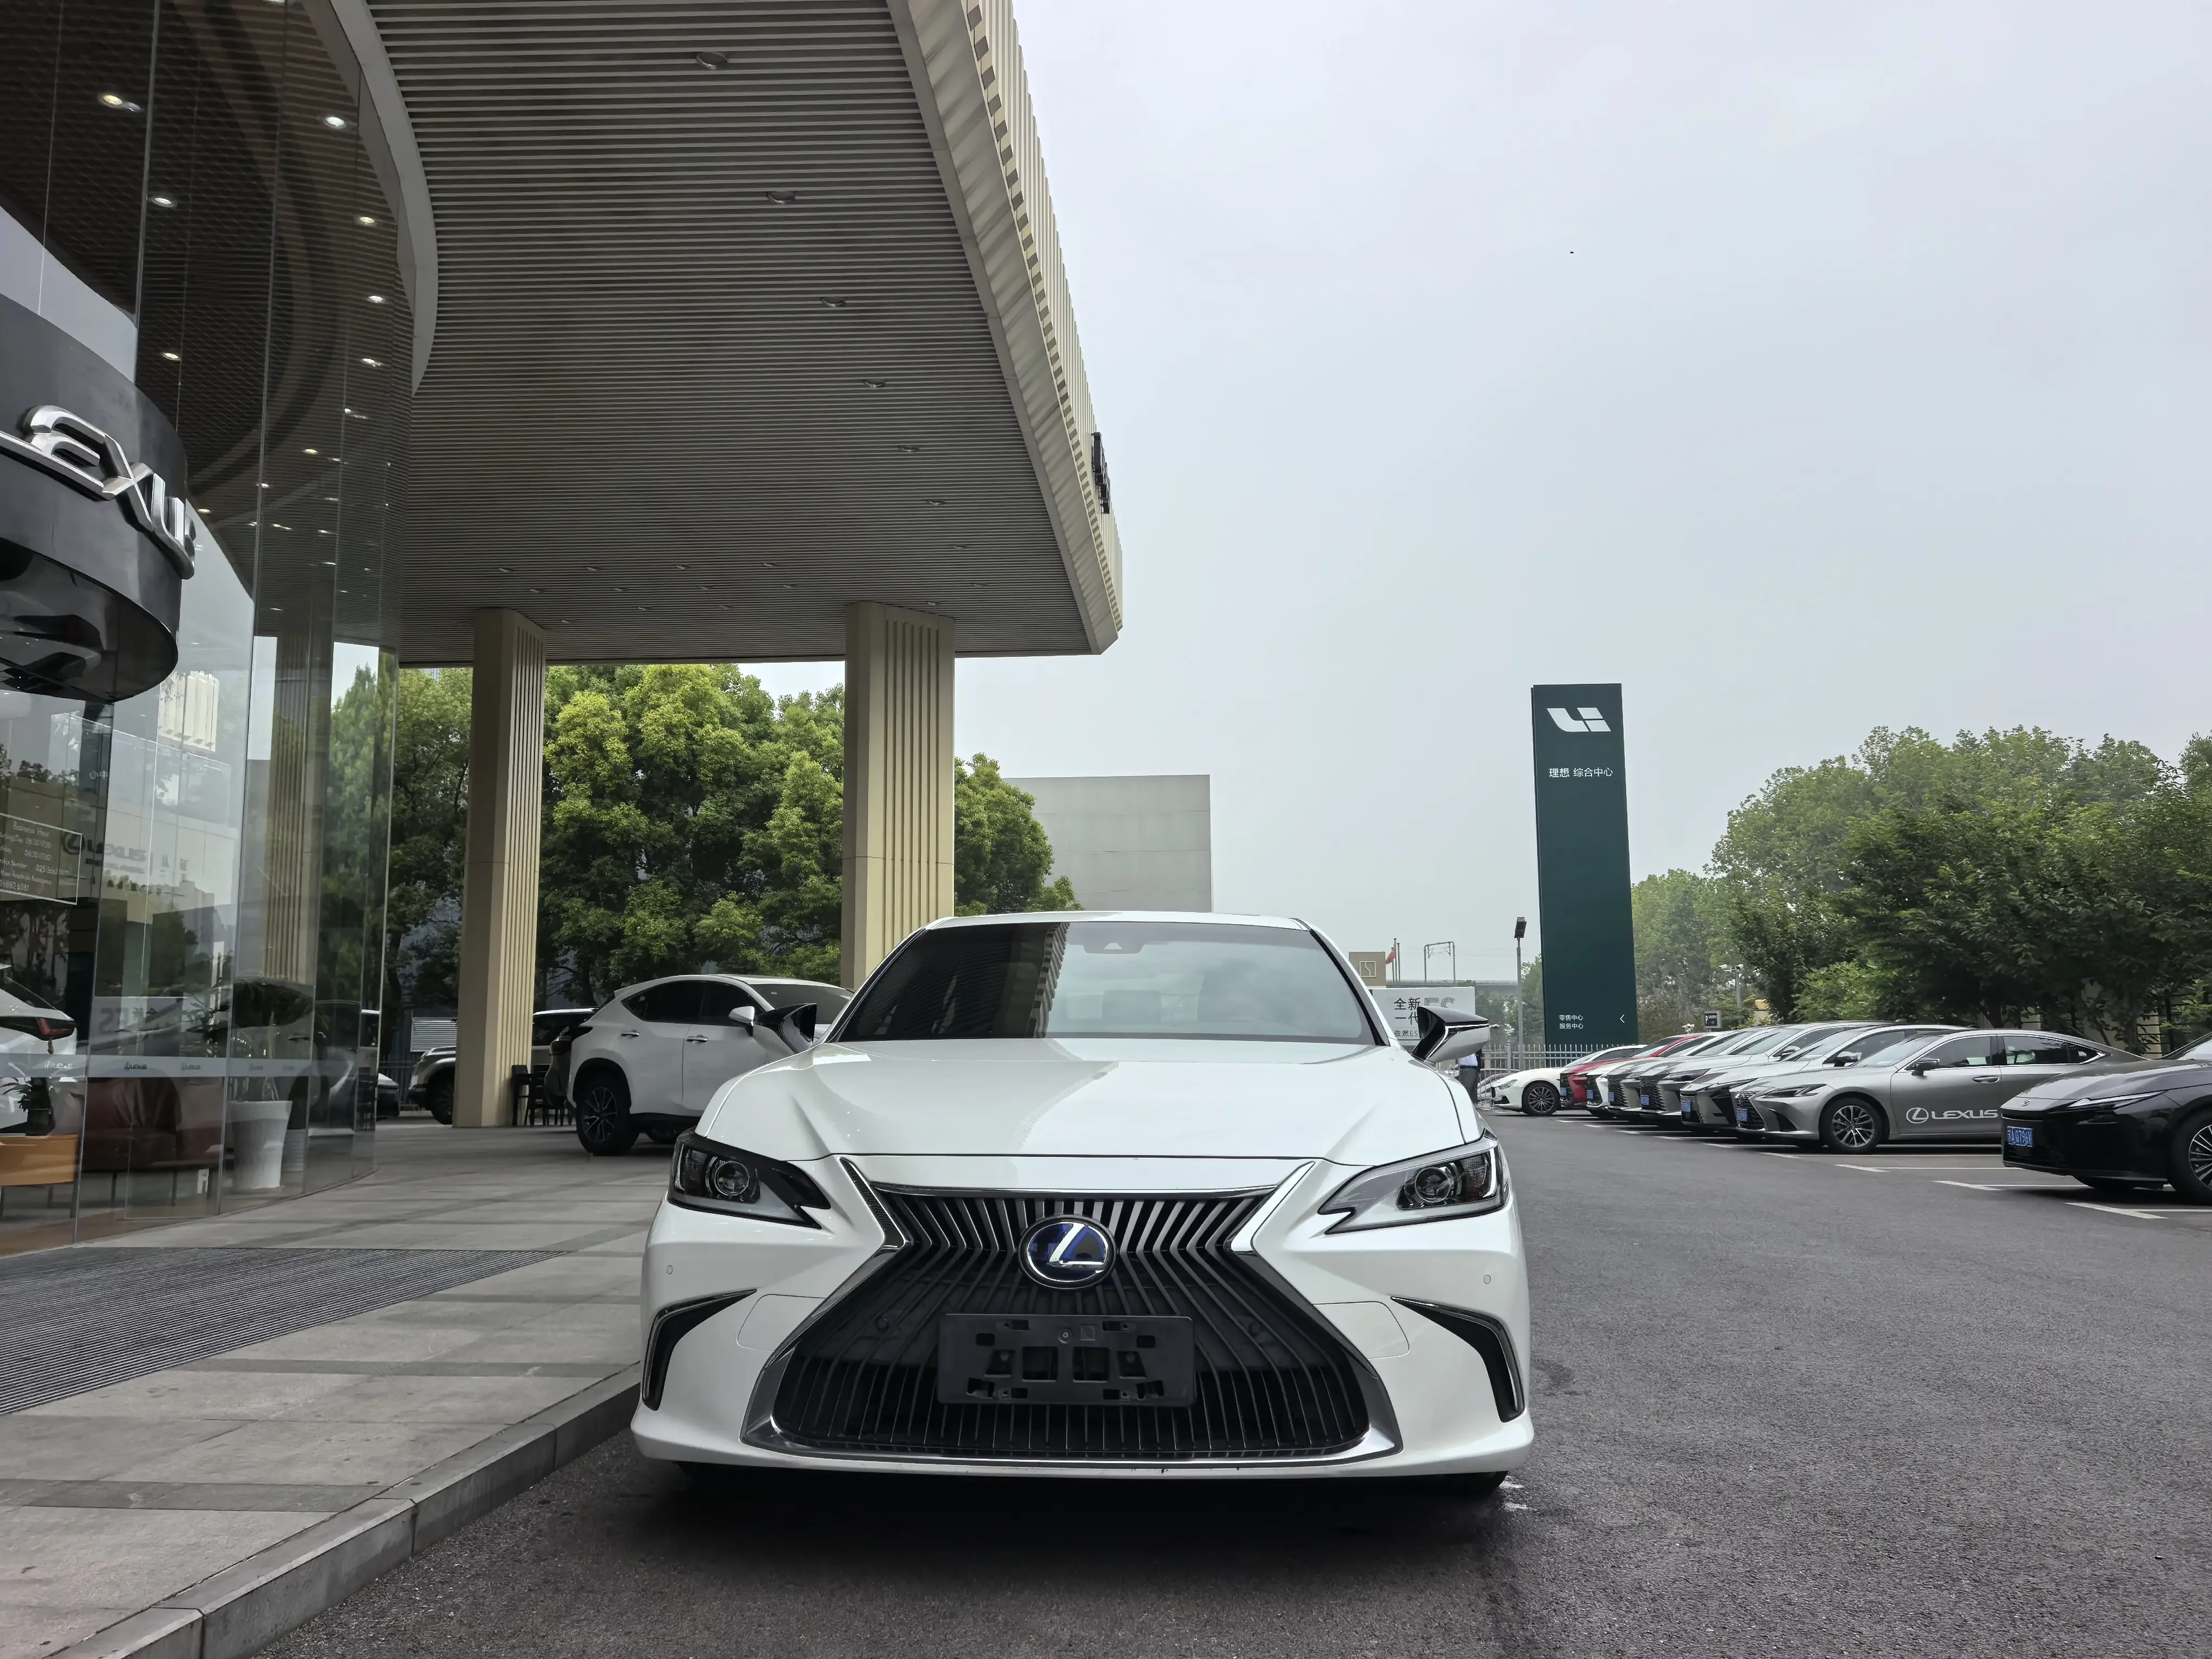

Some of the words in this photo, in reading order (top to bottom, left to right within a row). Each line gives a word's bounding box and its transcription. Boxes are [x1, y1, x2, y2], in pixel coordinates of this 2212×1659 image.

[1548, 767, 1570, 778] 理想
[1573, 767, 1613, 778] 综合中心
[1394, 997, 1420, 1010] 全新
[1394, 1011, 1419, 1025] 一代
[1931, 1109, 1999, 1120] LEXUS
